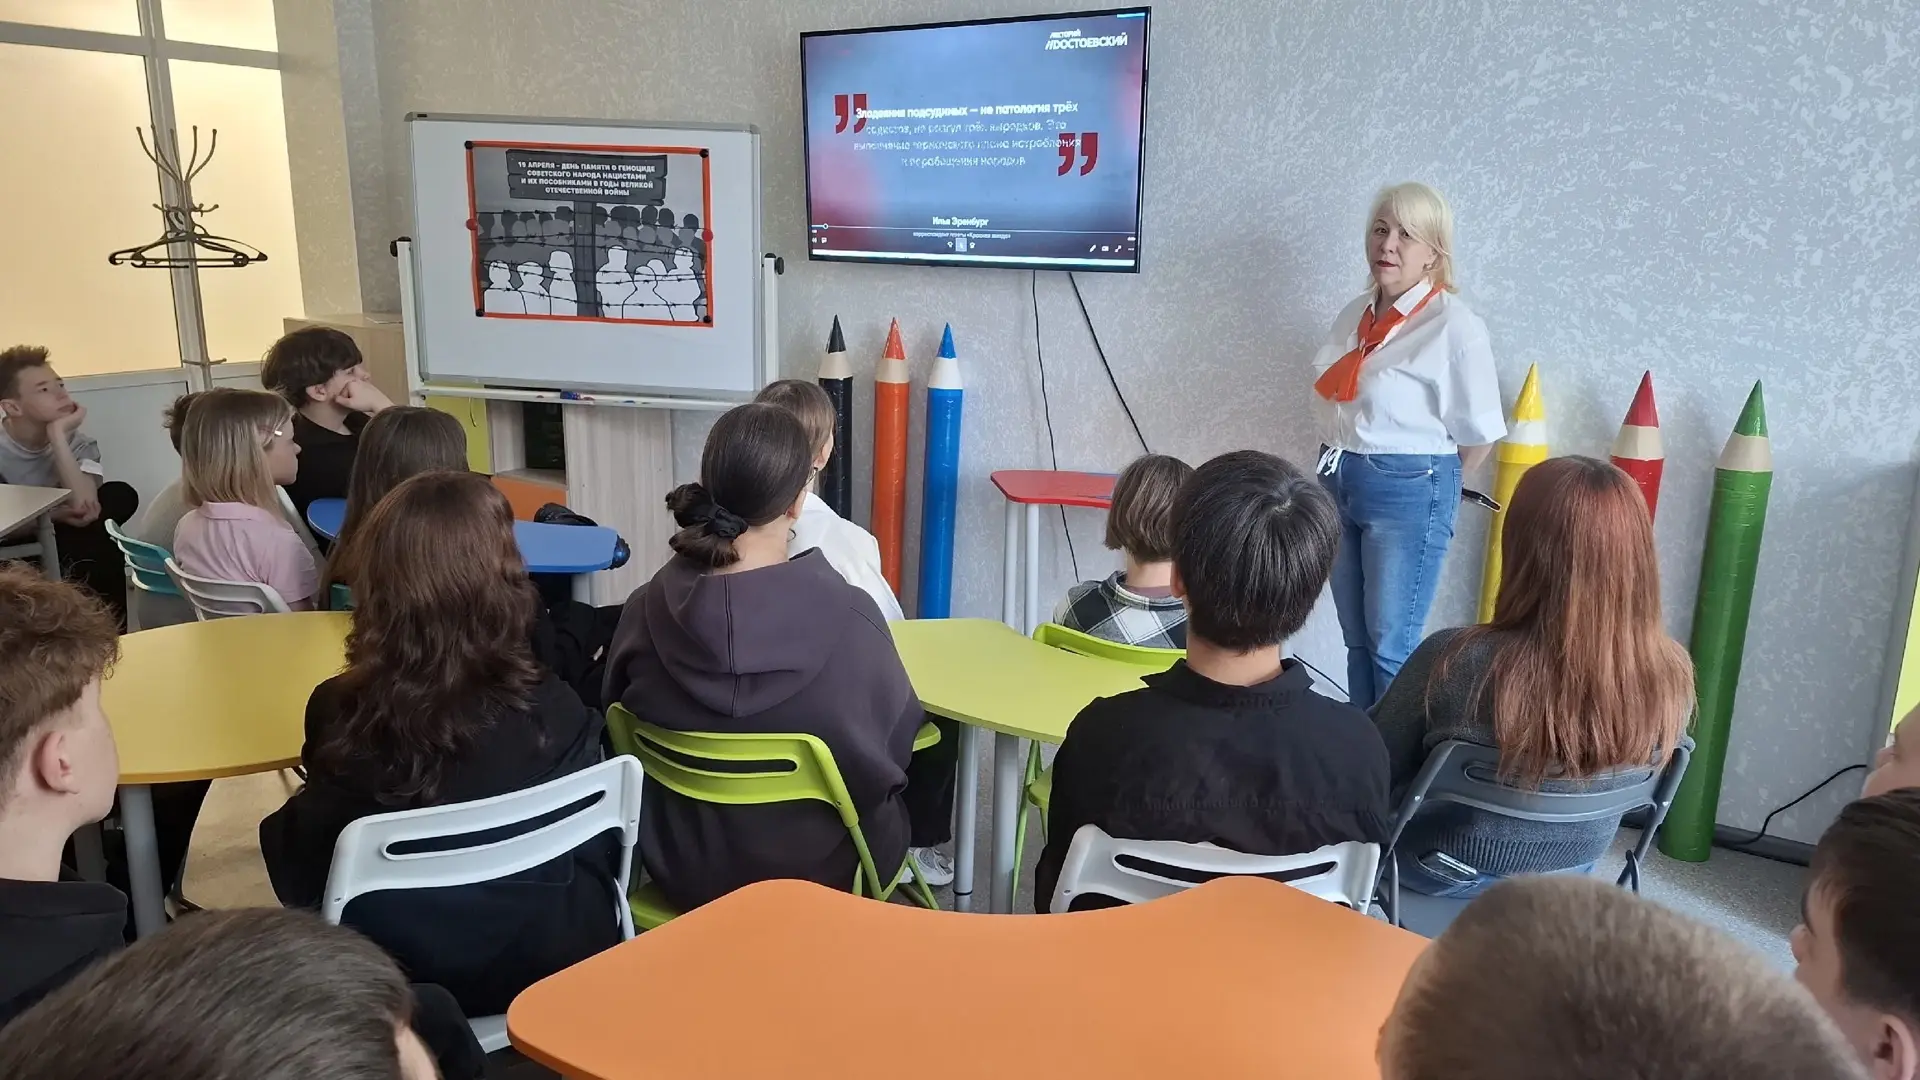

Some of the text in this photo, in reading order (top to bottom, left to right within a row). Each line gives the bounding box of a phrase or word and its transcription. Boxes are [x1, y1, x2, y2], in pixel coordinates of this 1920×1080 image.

[856, 108, 905, 119] Злодеяния
[907, 107, 968, 119] подсудимых
[980, 106, 994, 115] не
[995, 104, 1051, 115] патология
[1053, 101, 1078, 115] трёх
[518, 161, 527, 169] 19
[581, 163, 611, 171] ПАМЯТИ
[618, 165, 656, 173] ГЕНОЦИДЕ
[527, 169, 647, 180] СОВЕТСКОГО НАРОДА НАЦИСТАМИ
[539, 178, 593, 187] ПОСОБНИКАМИ
[600, 180, 620, 188] ГОДЫ
[620, 180, 654, 189] ВЕЛИКОЙ
[545, 186, 630, 196] ОТЕЧЕСТВЕННОЙ ВОЙНЫ
[932, 216, 989, 228] Илья Эренбург
